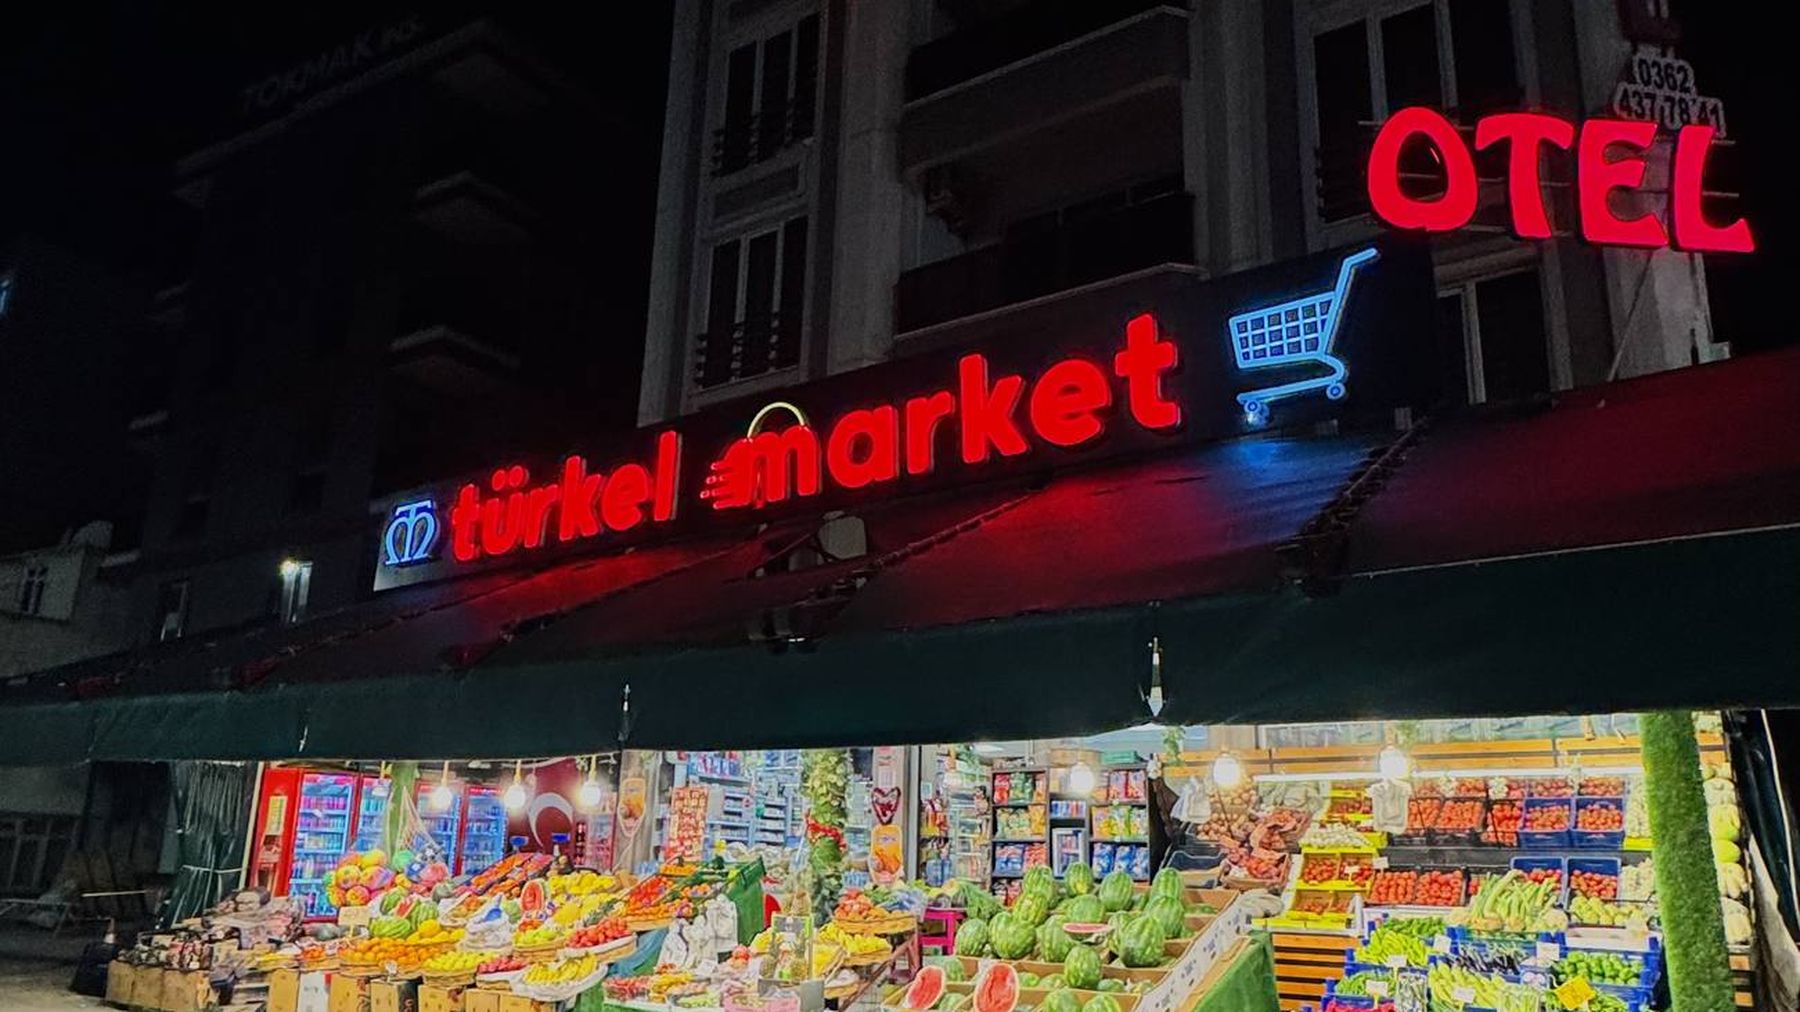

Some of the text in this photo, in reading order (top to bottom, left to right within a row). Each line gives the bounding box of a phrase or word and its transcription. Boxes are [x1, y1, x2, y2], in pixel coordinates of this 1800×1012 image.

[1620, 89, 1656, 119] 437
[1664, 95, 1690, 124] 78
[1639, 59, 1691, 94] 0362
[1368, 107, 1755, 252] OTEL
[452, 432, 678, 561] türkel
[700, 314, 1181, 509] market
